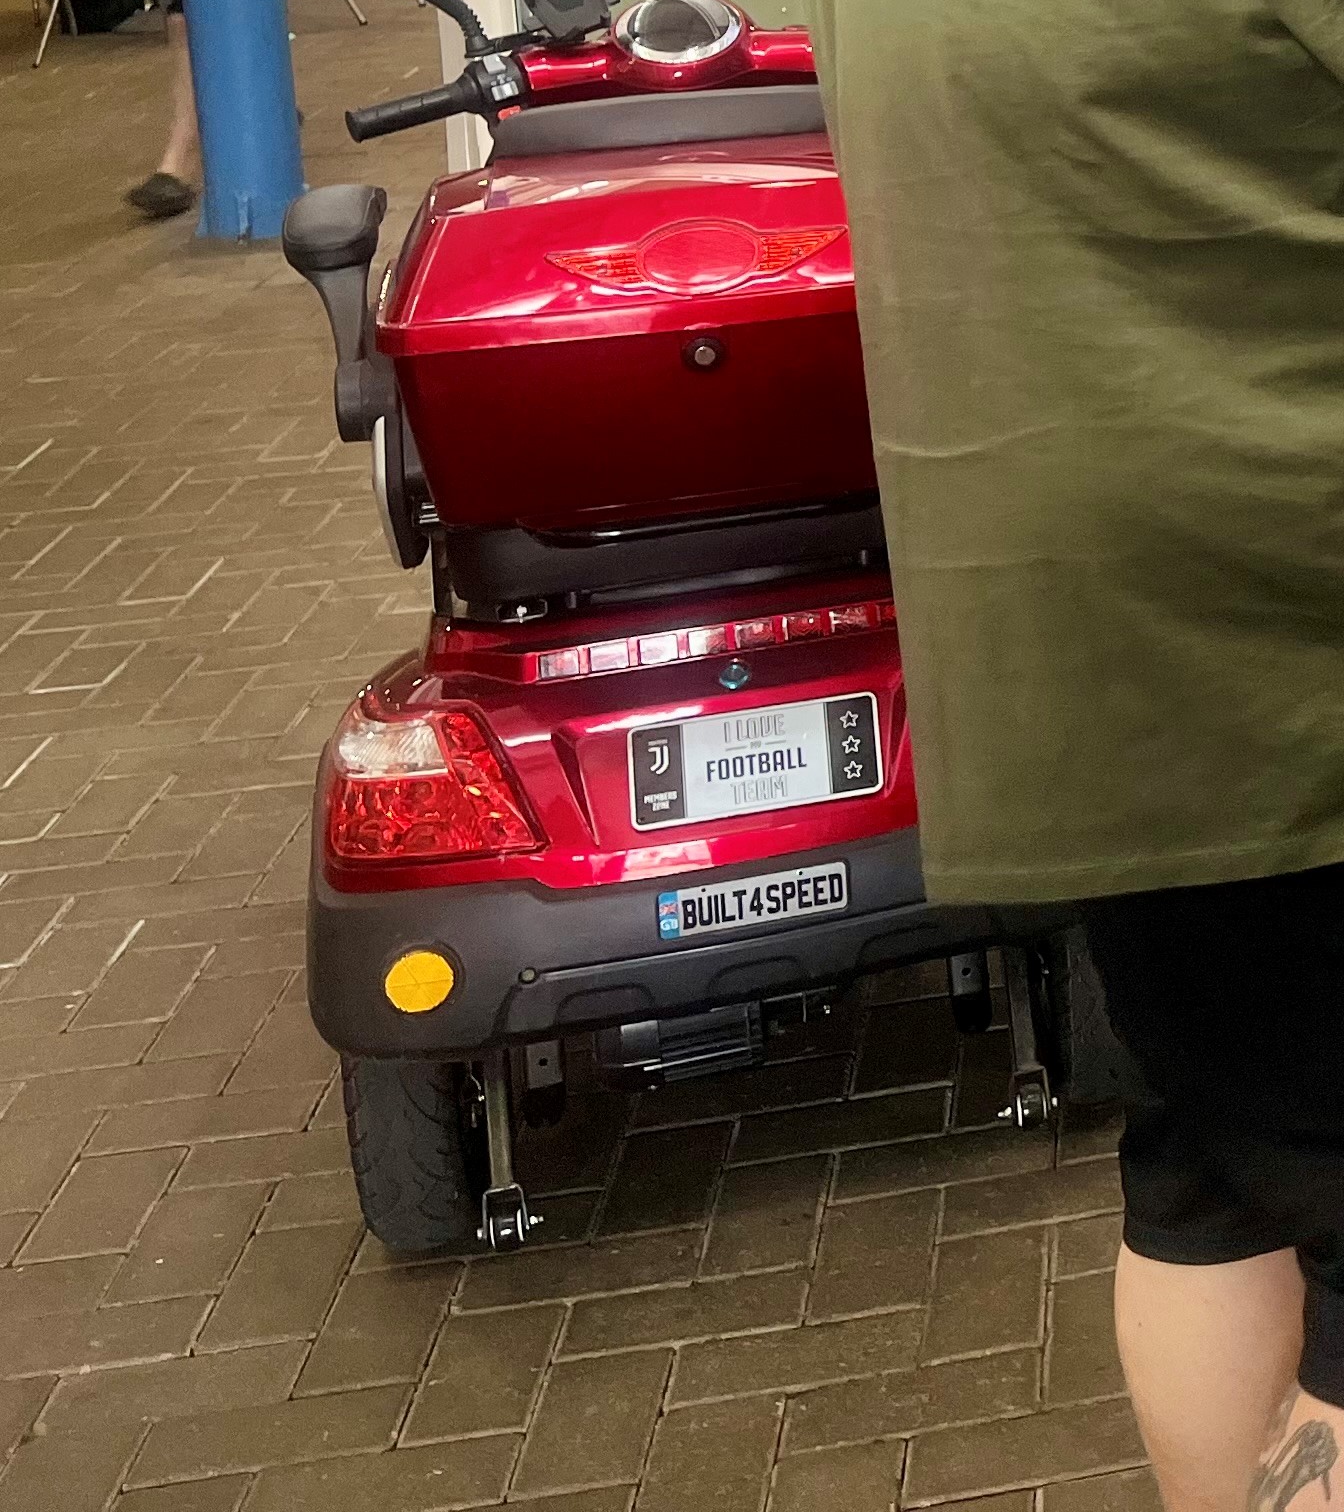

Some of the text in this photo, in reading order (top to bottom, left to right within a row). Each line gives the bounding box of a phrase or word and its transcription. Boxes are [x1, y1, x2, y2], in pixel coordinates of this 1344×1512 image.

[723, 714, 786, 744] I LOVE
[706, 747, 808, 783] FOOTBALL
[730, 774, 789, 805] TEAM
[681, 873, 844, 931] BUILT4SPEED
